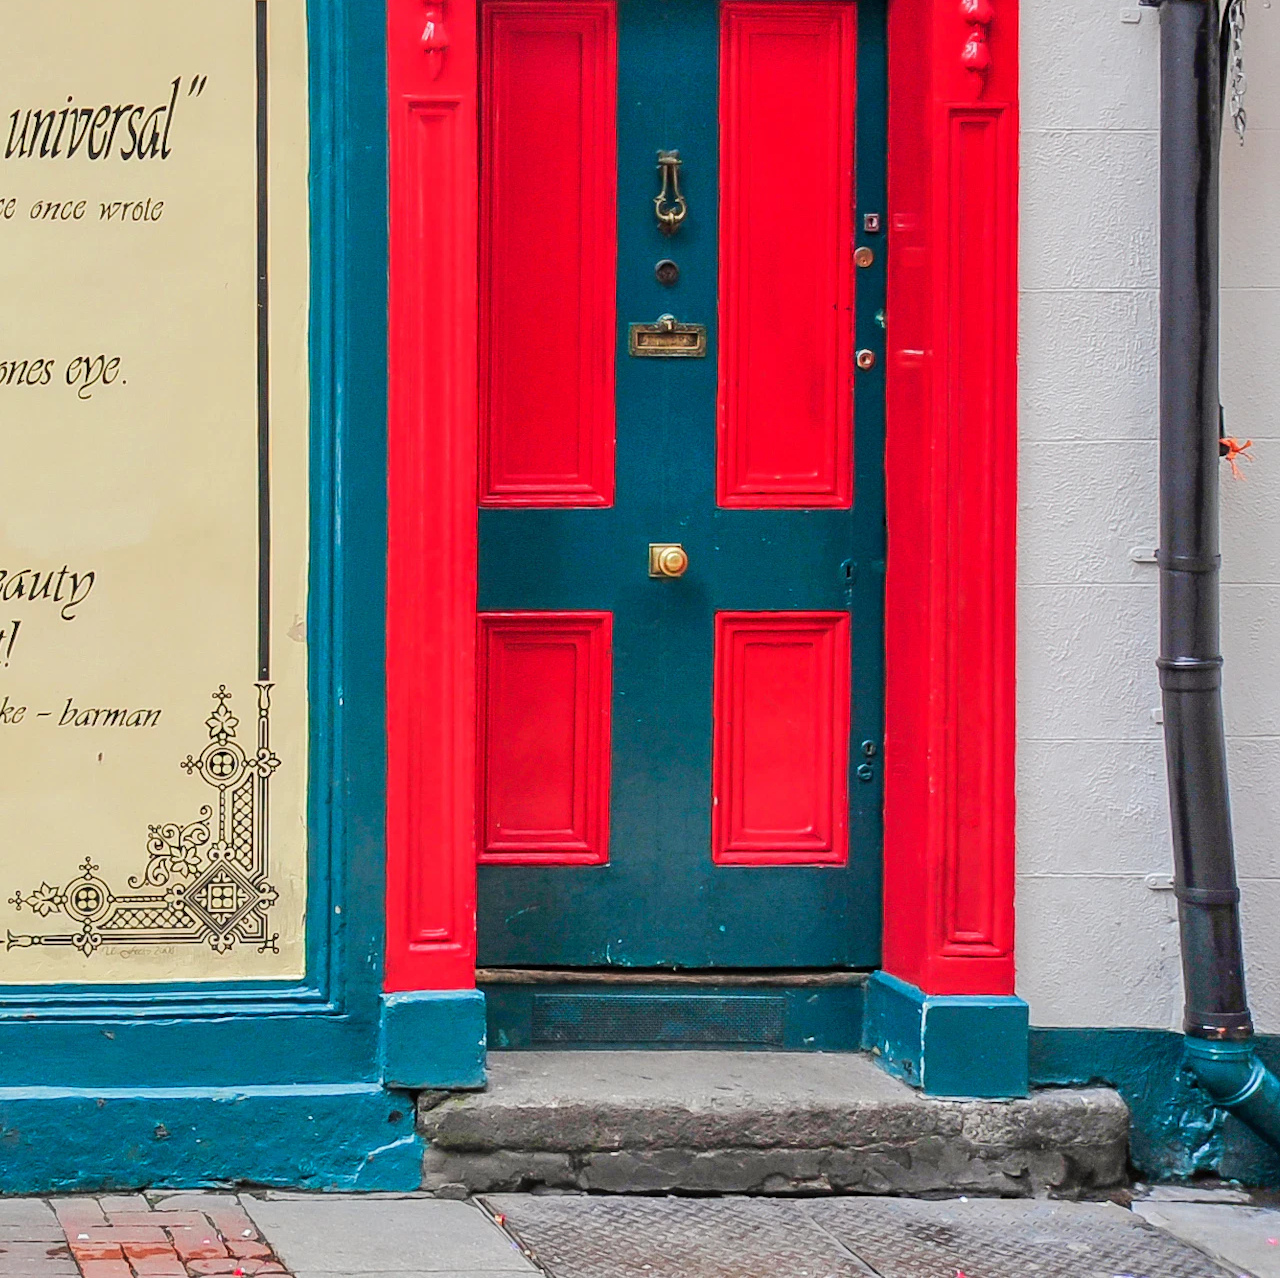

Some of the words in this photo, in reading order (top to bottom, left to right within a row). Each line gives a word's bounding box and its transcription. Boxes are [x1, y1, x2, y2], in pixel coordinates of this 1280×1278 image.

[30, 200, 87, 221] once
[99, 197, 164, 222] wrote
[65, 354, 127, 400] eye.
[58, 697, 162, 728] barman
